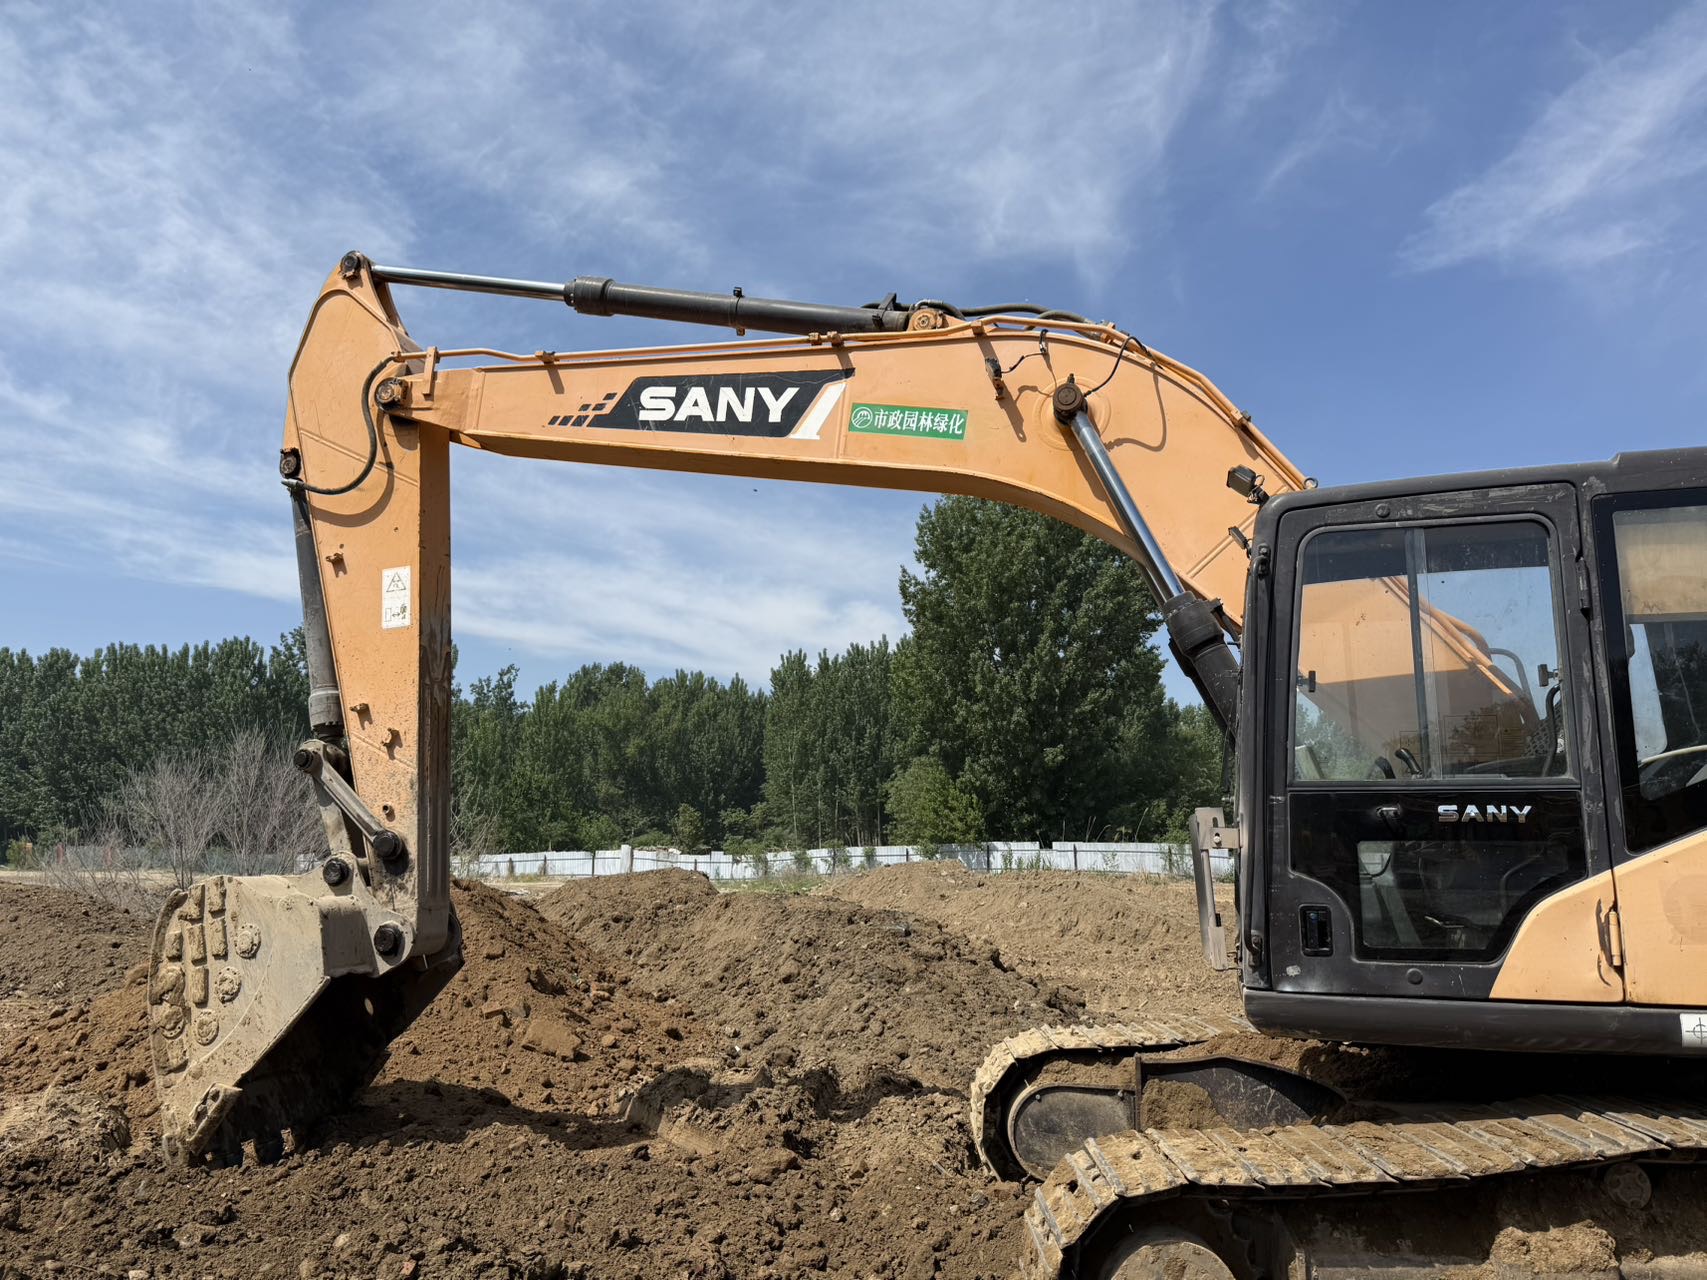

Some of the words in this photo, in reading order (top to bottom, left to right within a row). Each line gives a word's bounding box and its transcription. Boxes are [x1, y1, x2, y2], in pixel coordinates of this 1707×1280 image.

[638, 386, 800, 423] SANY
[873, 408, 965, 435] 市政园林绿化
[1437, 804, 1532, 823] SANY
